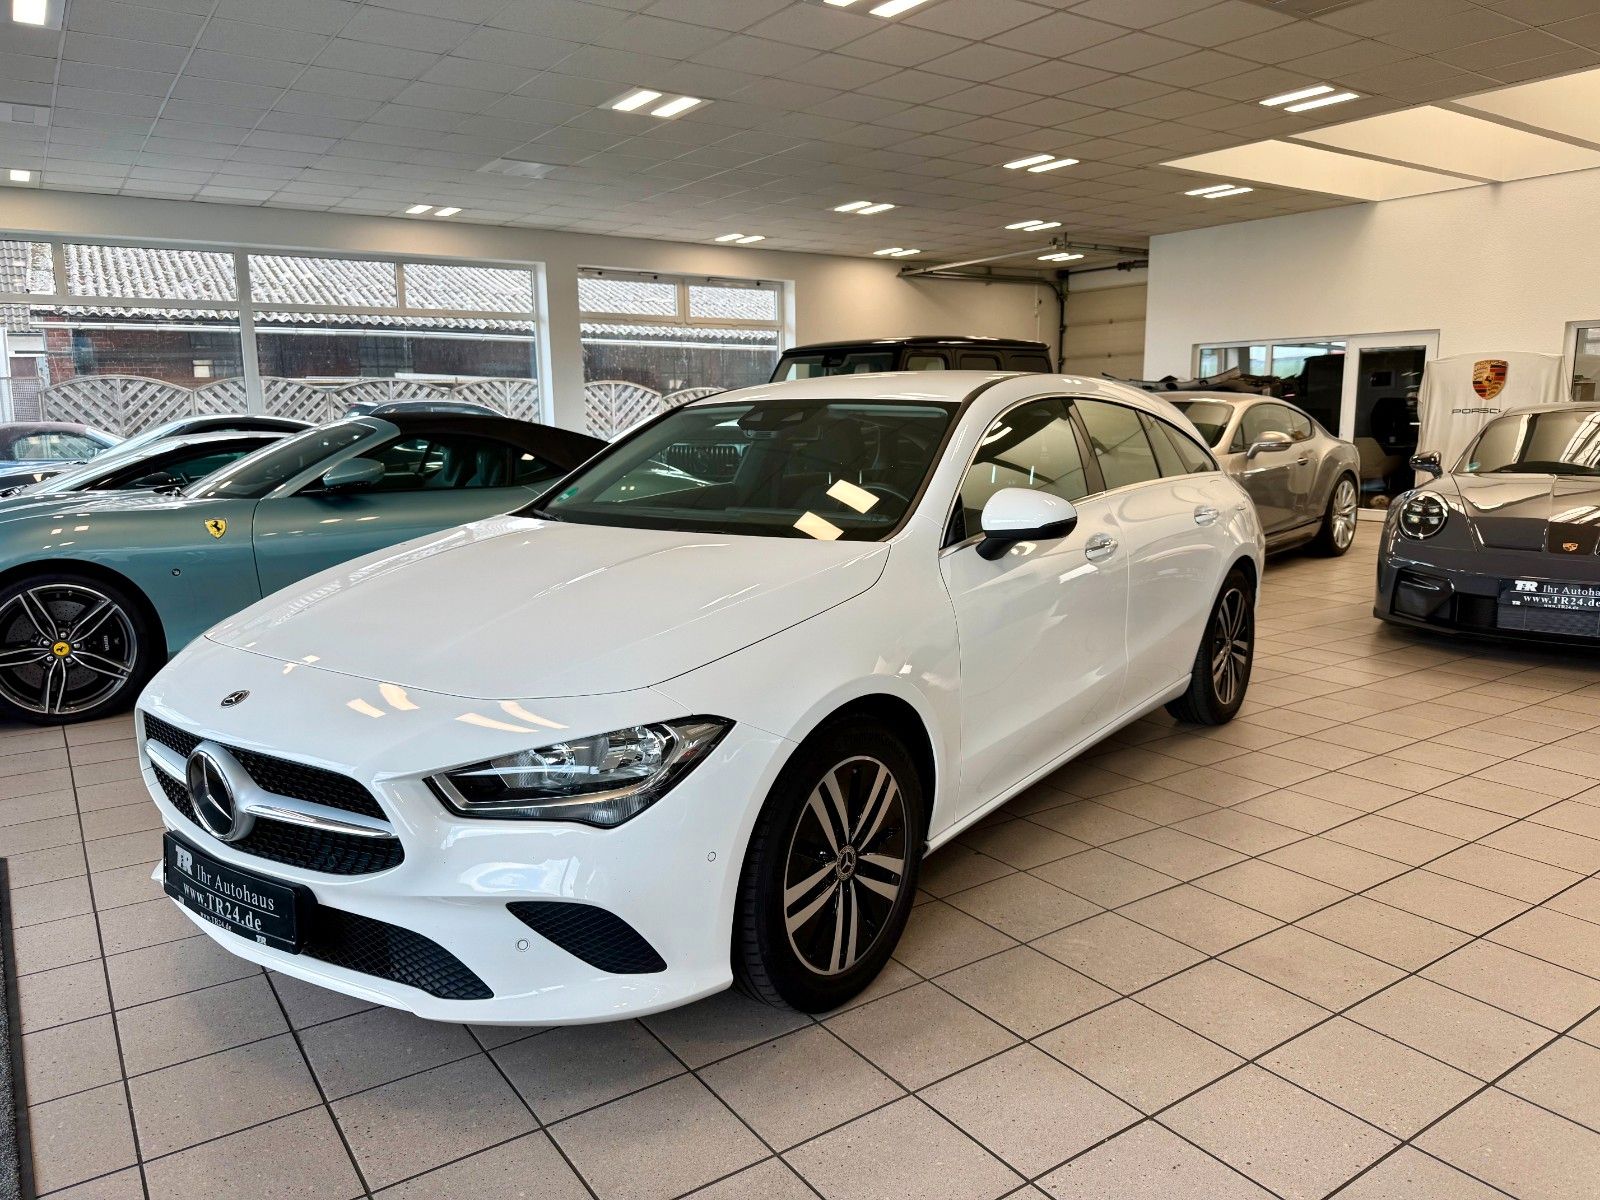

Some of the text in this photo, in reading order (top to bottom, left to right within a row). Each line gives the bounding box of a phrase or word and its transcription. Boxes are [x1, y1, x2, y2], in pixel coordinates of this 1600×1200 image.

[1523, 595, 1600, 607] www.TR24.de
[1542, 584, 1559, 594] Ihr
[196, 863, 275, 911] Ihr Autohaus
[183, 882, 262, 931] www.TR24.de
